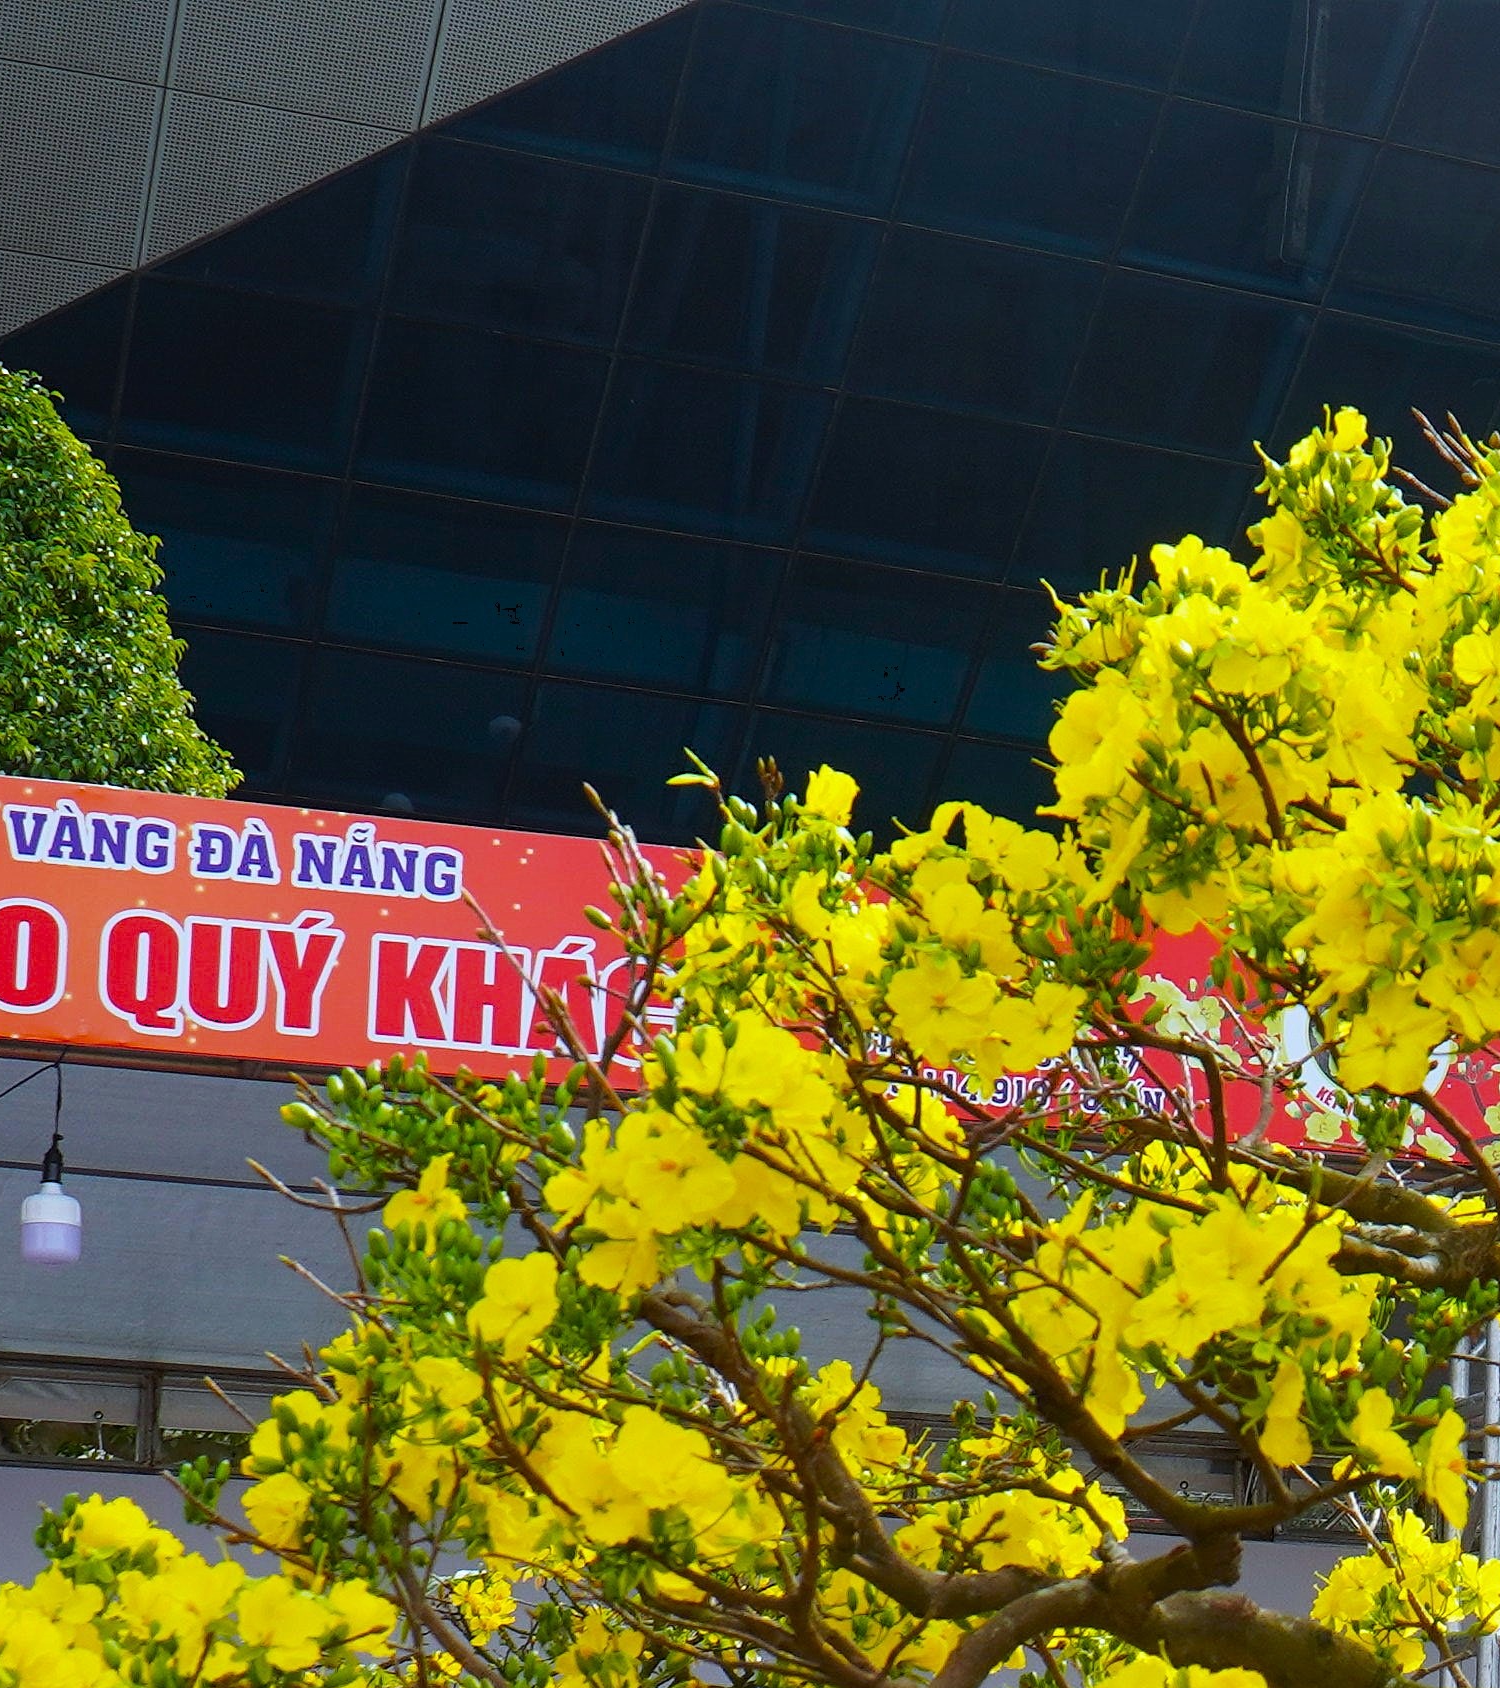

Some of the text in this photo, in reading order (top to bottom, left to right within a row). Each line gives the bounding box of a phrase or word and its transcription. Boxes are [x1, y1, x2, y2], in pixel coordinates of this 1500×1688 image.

[3, 799, 176, 876] VÀNG
[190, 817, 280, 886] ĐÀ
[293, 822, 464, 902] NẴNG
[100, 908, 345, 1038] QUÝ
[367, 933, 678, 1067] KHÁC
